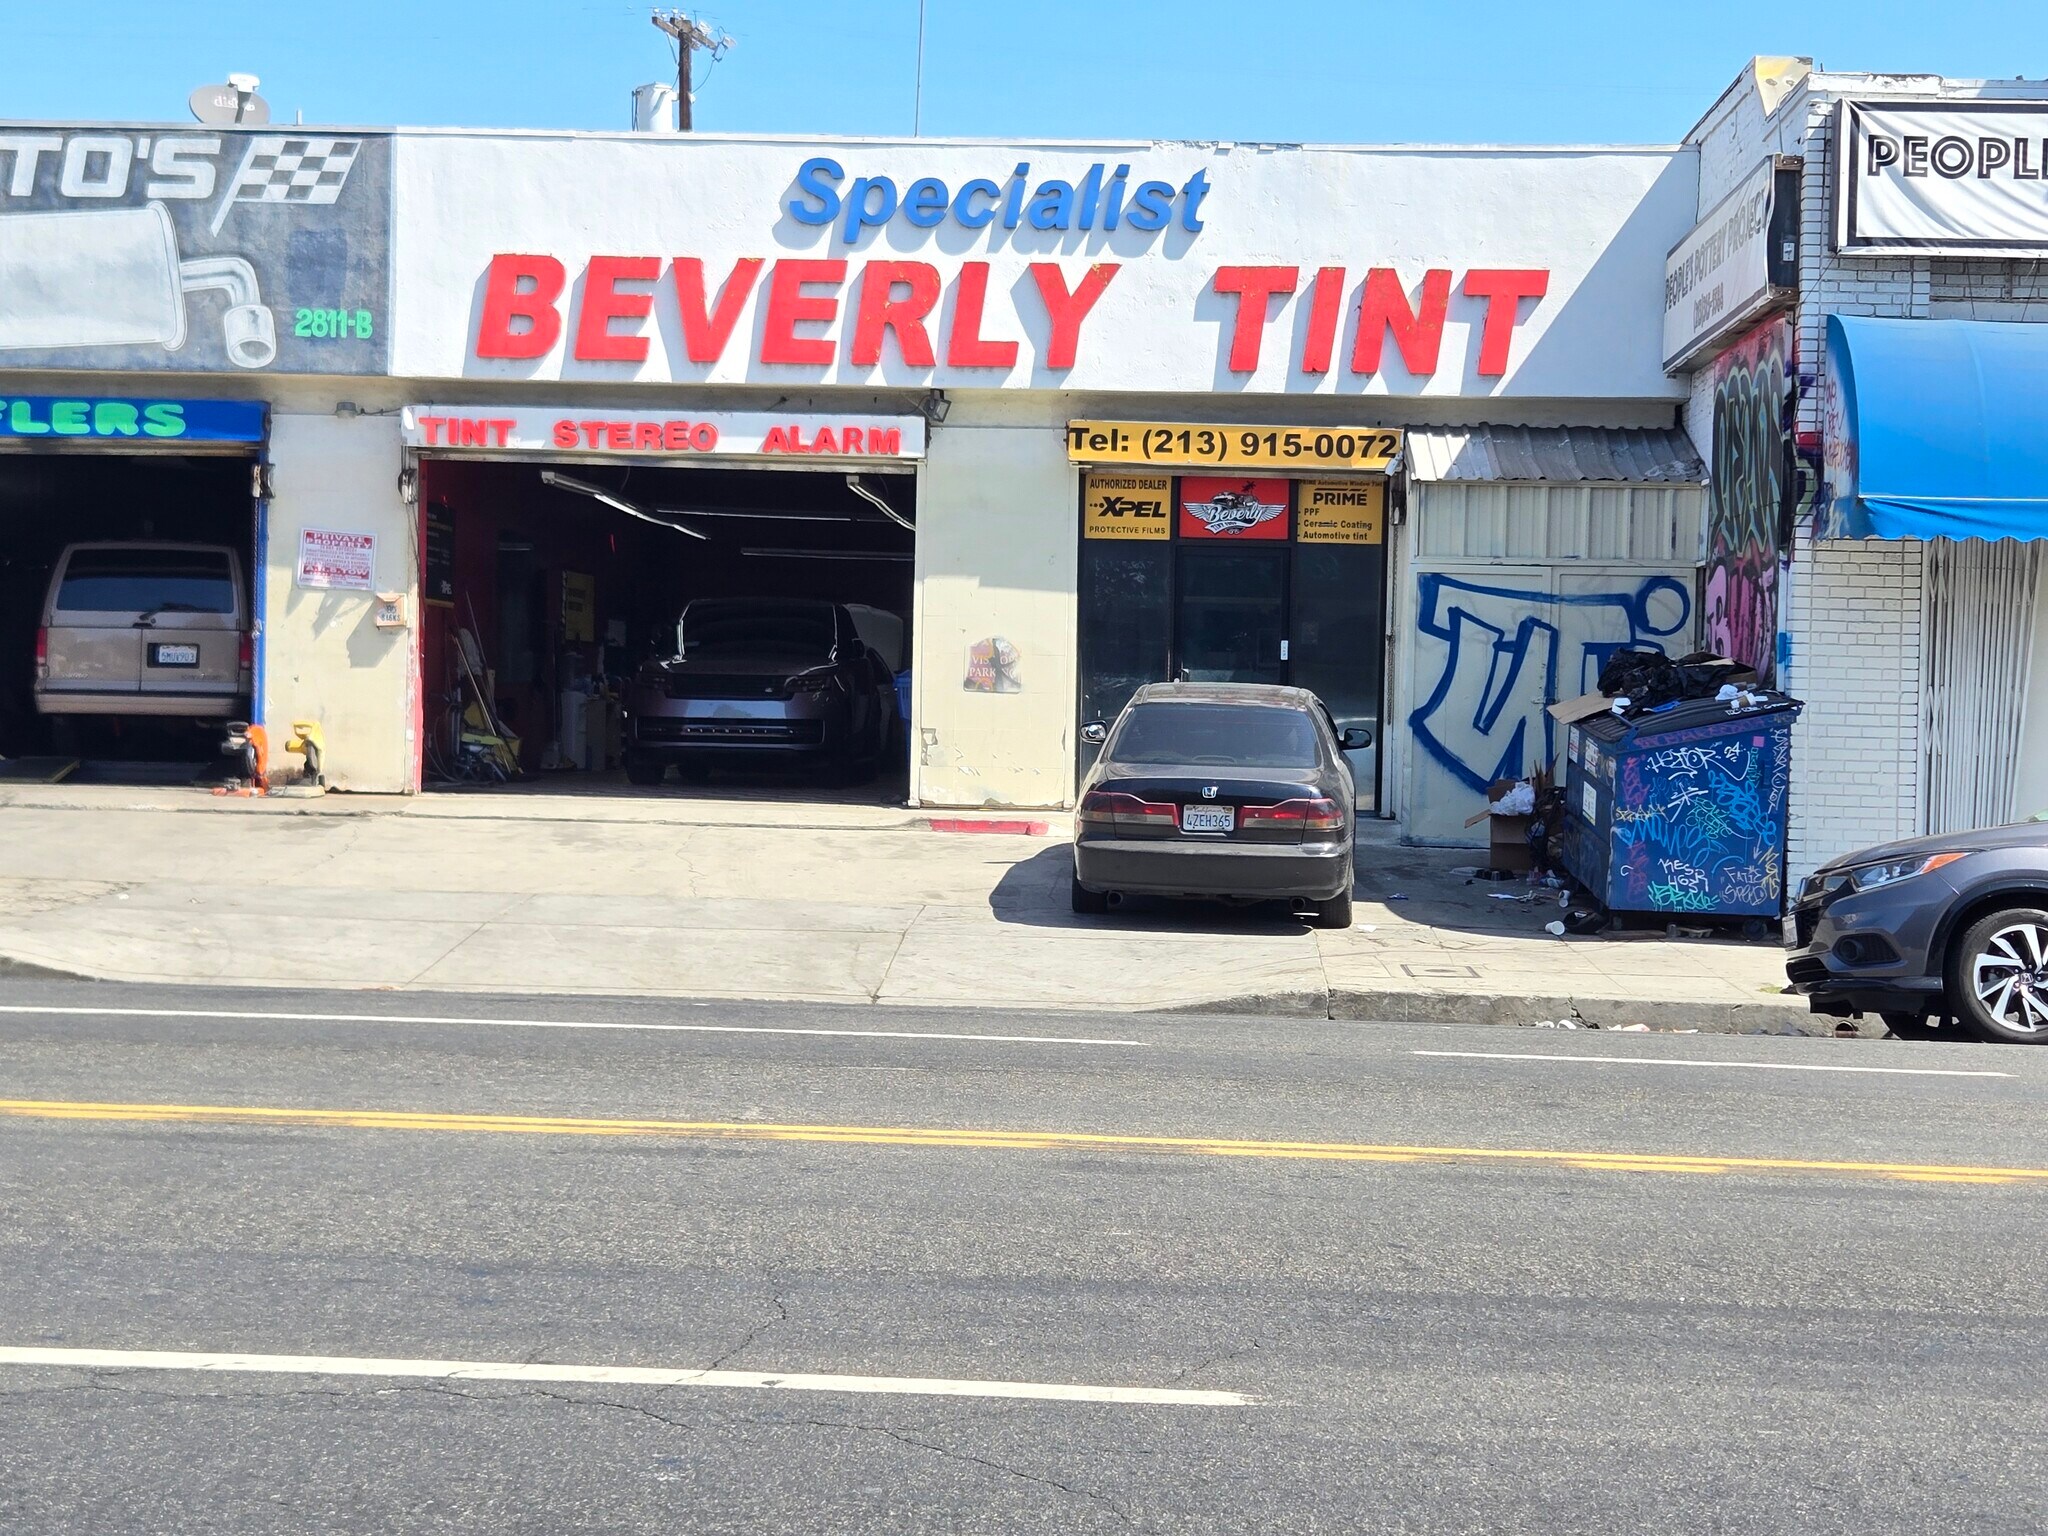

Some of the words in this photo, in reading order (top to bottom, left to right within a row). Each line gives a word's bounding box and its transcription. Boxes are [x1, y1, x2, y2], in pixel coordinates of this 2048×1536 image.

[1867, 134, 2048, 180] PEOPL
[790, 157, 1210, 244] Specialist
[1694, 222, 1727, 287] POTTERY
[293, 309, 373, 339] 2811-B
[476, 254, 1122, 369] BEVERLY
[1213, 265, 1550, 376] TINT
[0, 401, 186, 437] LERS
[419, 417, 516, 447] TINT
[553, 421, 720, 452] STEREO
[763, 425, 902, 454] ALARM
[1070, 427, 1129, 451] Tel:
[1142, 429, 1228, 461] (213)
[1240, 432, 1398, 458] 915-0072
[1090, 479, 1137, 490] AUTHORIZED
[1138, 480, 1168, 490] DEALER
[1098, 496, 1167, 518] XPEL
[1207, 501, 1263, 522] Beverly
[1303, 508, 1320, 516] PPF
[1089, 526, 1139, 534] PROTECTIVE
[1303, 531, 1350, 540] Automotive
[1353, 532, 1368, 540] tint
[1340, 520, 1373, 531] Coating
[306, 538, 371, 549] PROPERTY
[313, 532, 364, 542] PRIVATE
[1186, 814, 1231, 828] 4ZEH365
